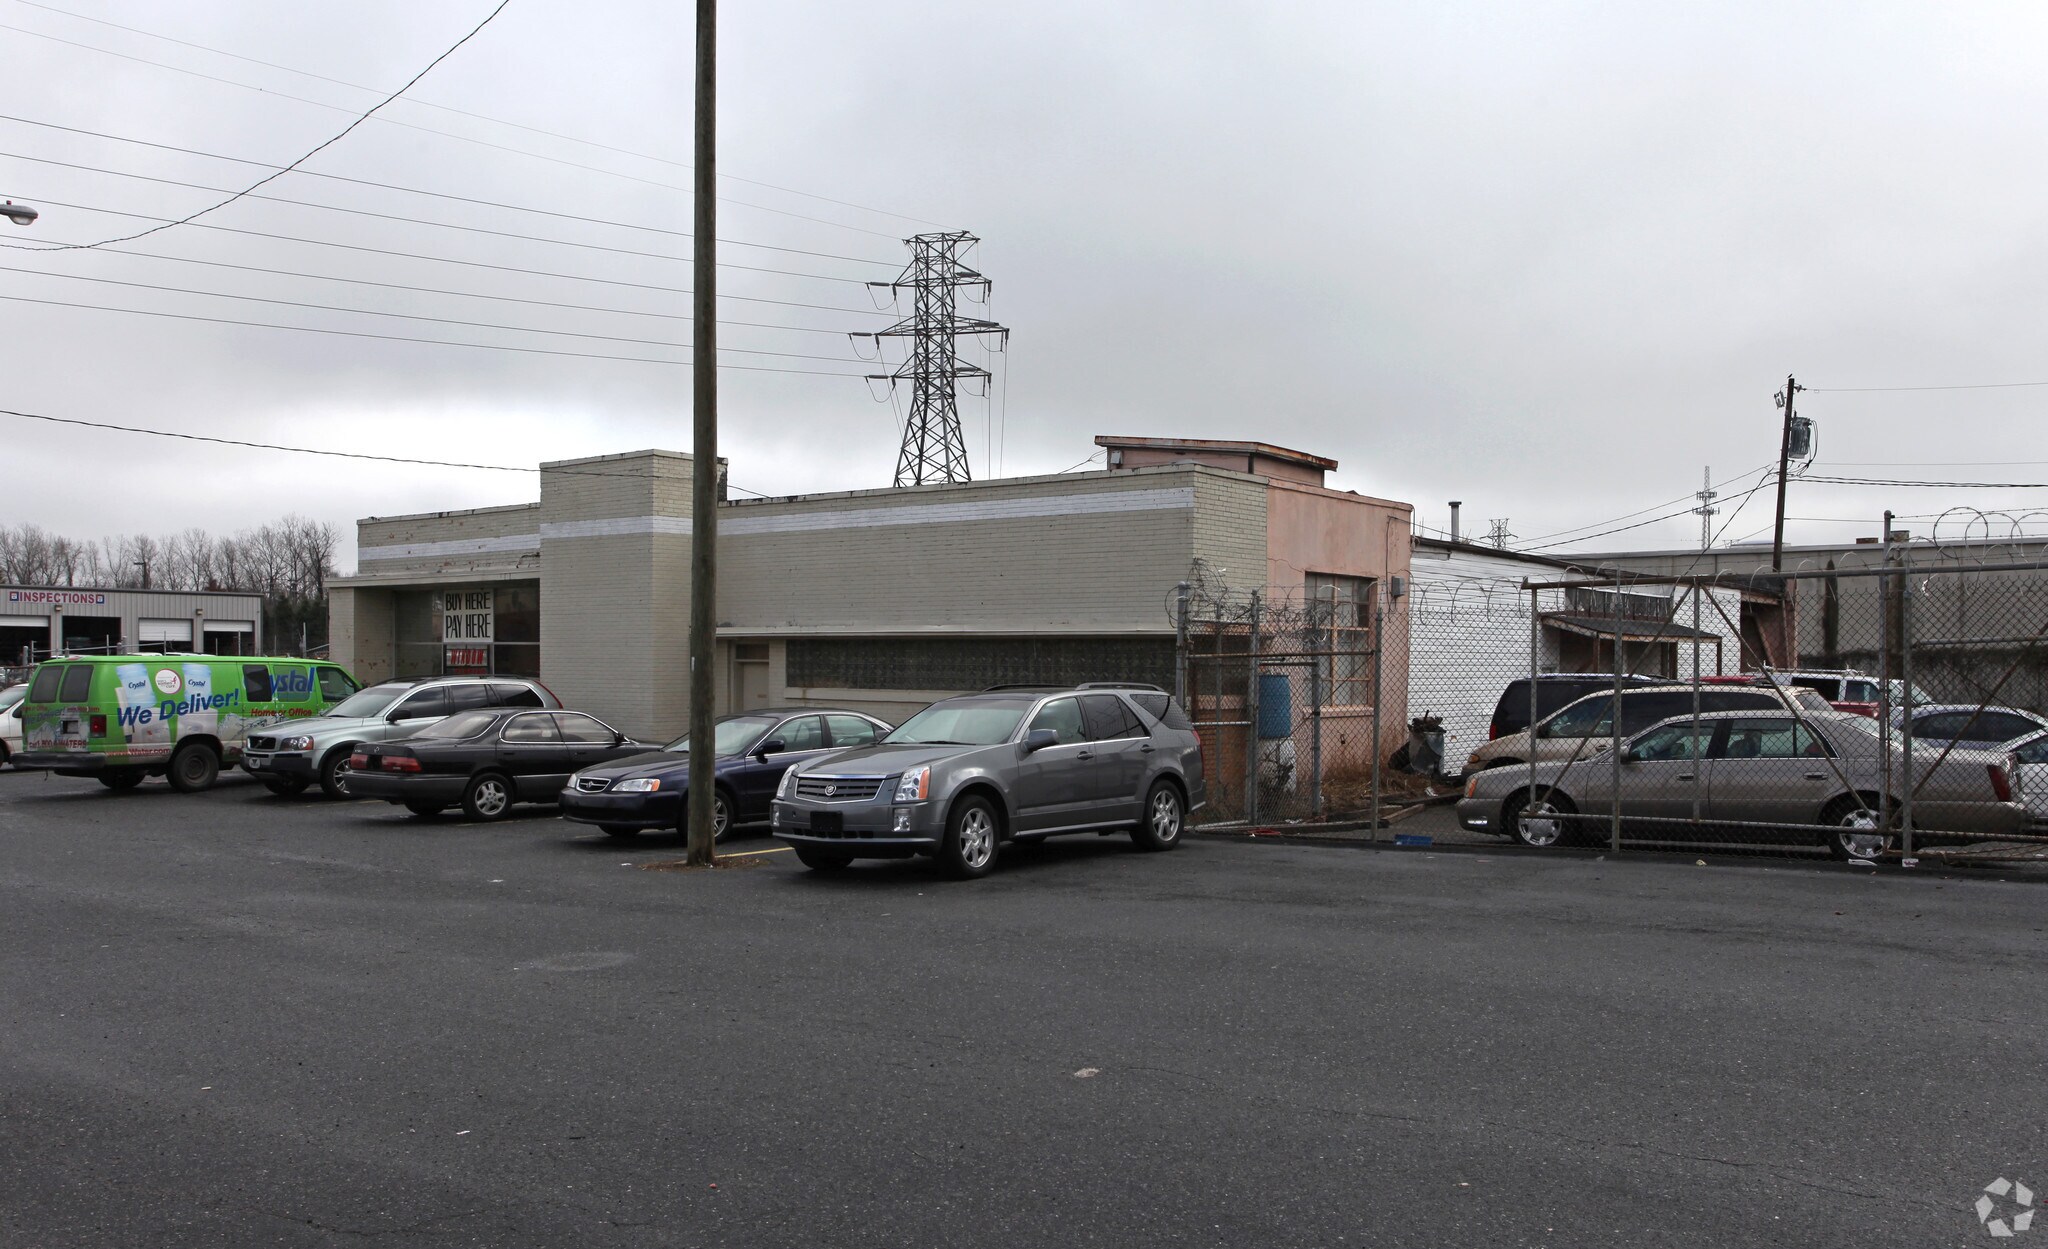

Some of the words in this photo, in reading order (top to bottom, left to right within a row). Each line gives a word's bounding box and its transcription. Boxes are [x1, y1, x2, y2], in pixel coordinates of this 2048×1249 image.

[20, 591, 95, 604] INSPECTIONS
[445, 593, 462, 611] BUY
[465, 592, 491, 610] HERE
[445, 615, 462, 638] PAY
[466, 613, 491, 638] HERE
[128, 680, 146, 690] Crystal
[188, 679, 206, 688] Crystal
[268, 667, 315, 697] ystal
[117, 706, 152, 726] We
[159, 688, 239, 721] Deliver!
[250, 708, 276, 717] Home
[288, 708, 313, 717] Office
